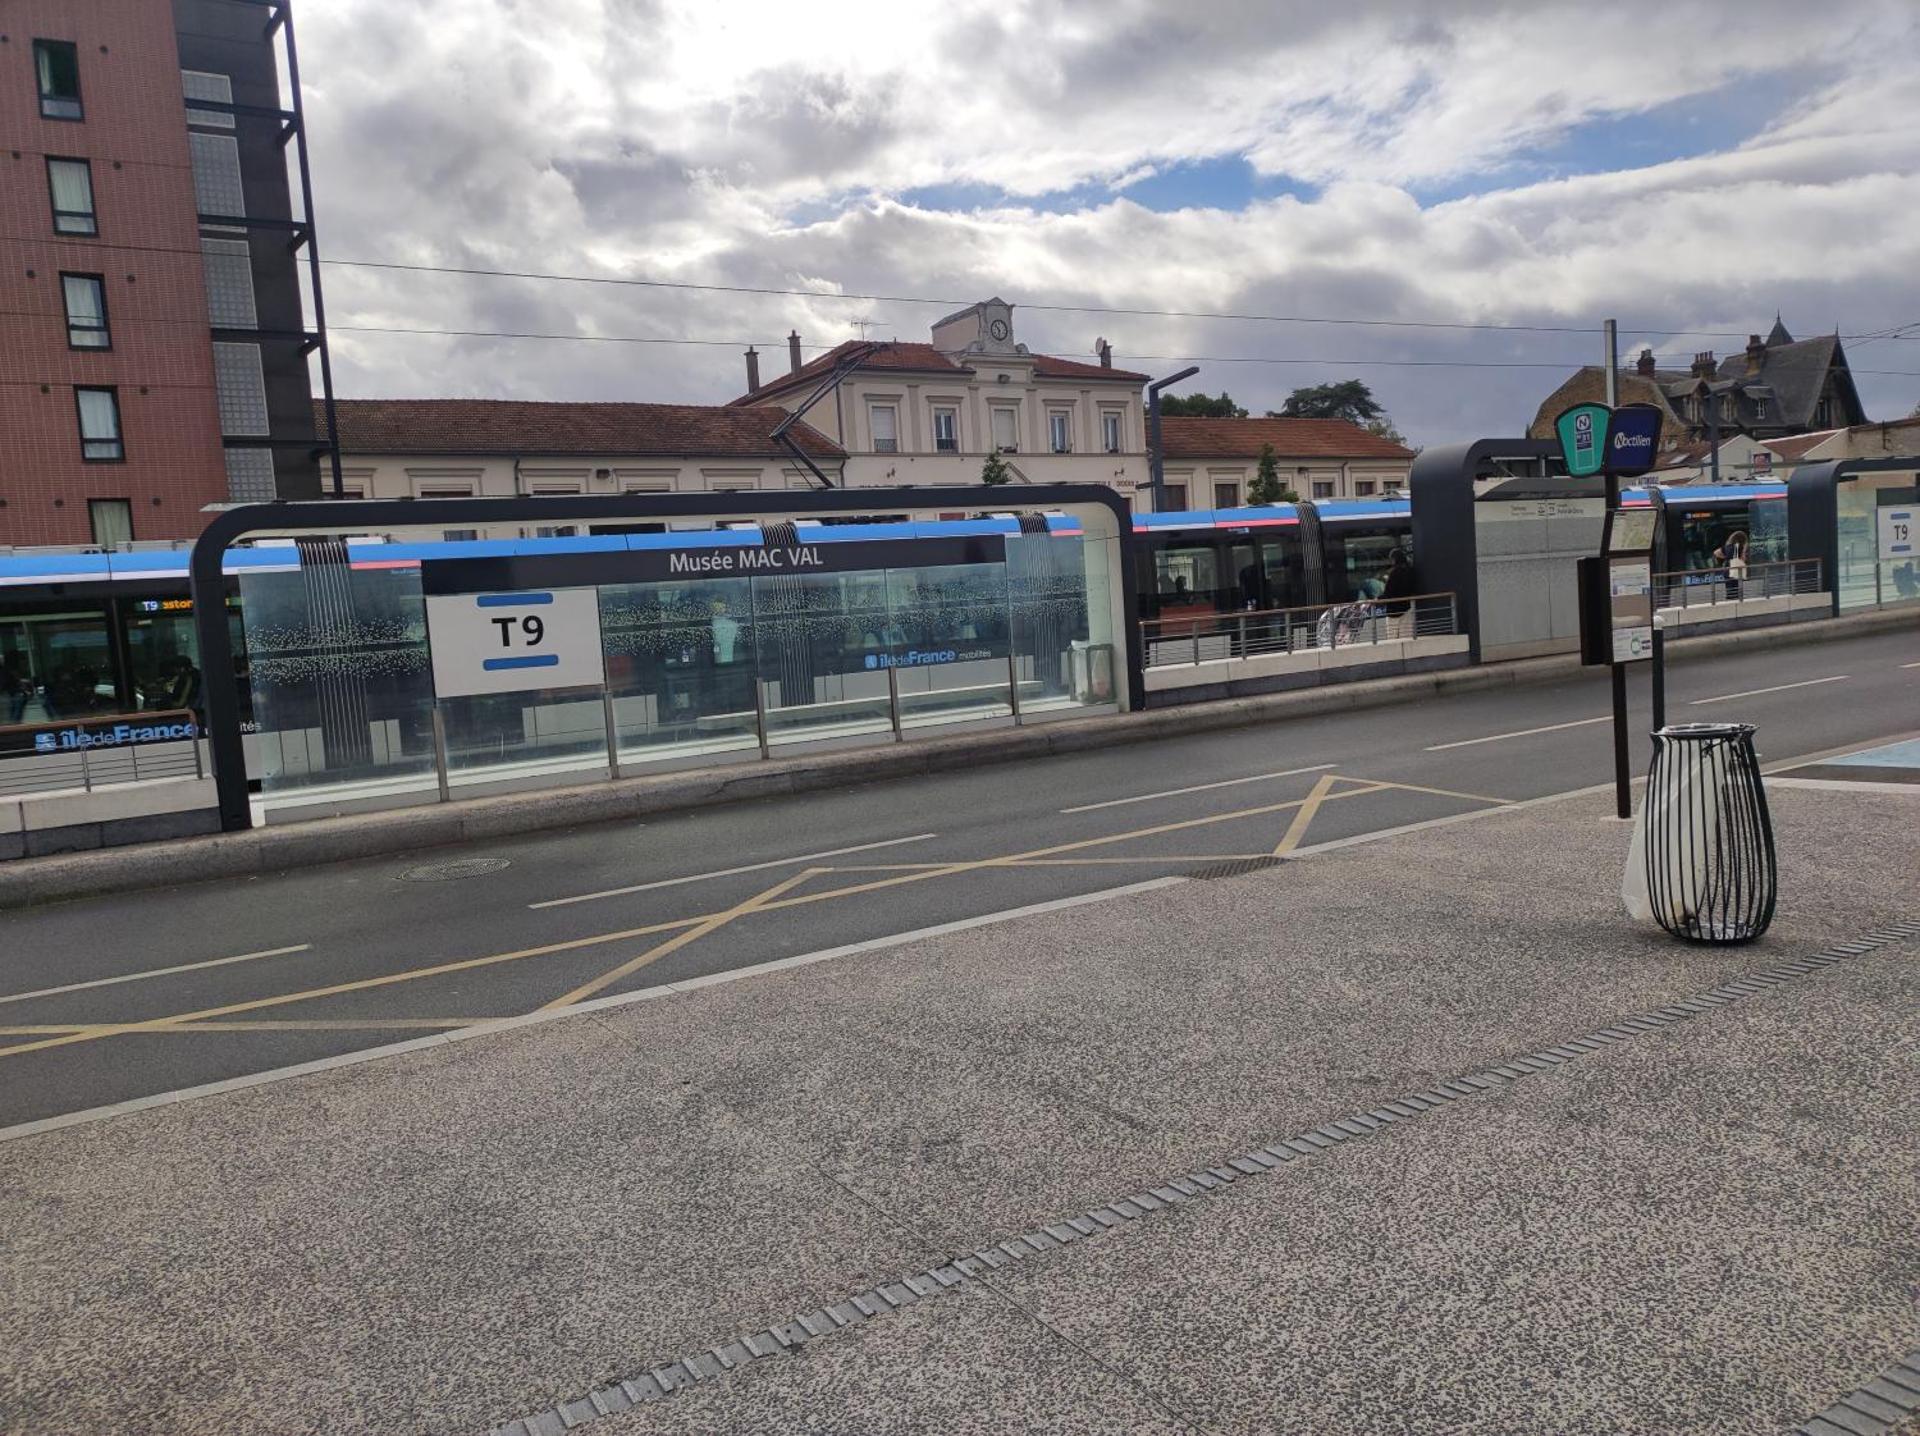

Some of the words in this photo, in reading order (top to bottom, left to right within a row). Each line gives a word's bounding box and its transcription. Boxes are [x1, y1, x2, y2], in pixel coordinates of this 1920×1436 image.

[1614, 432, 1651, 449] Noctilien
[1894, 524, 1908, 541] T9
[670, 551, 733, 573] Musée
[739, 549, 784, 569] MAC
[788, 547, 824, 567] VAL
[142, 601, 158, 611] T9
[491, 615, 544, 647] T9
